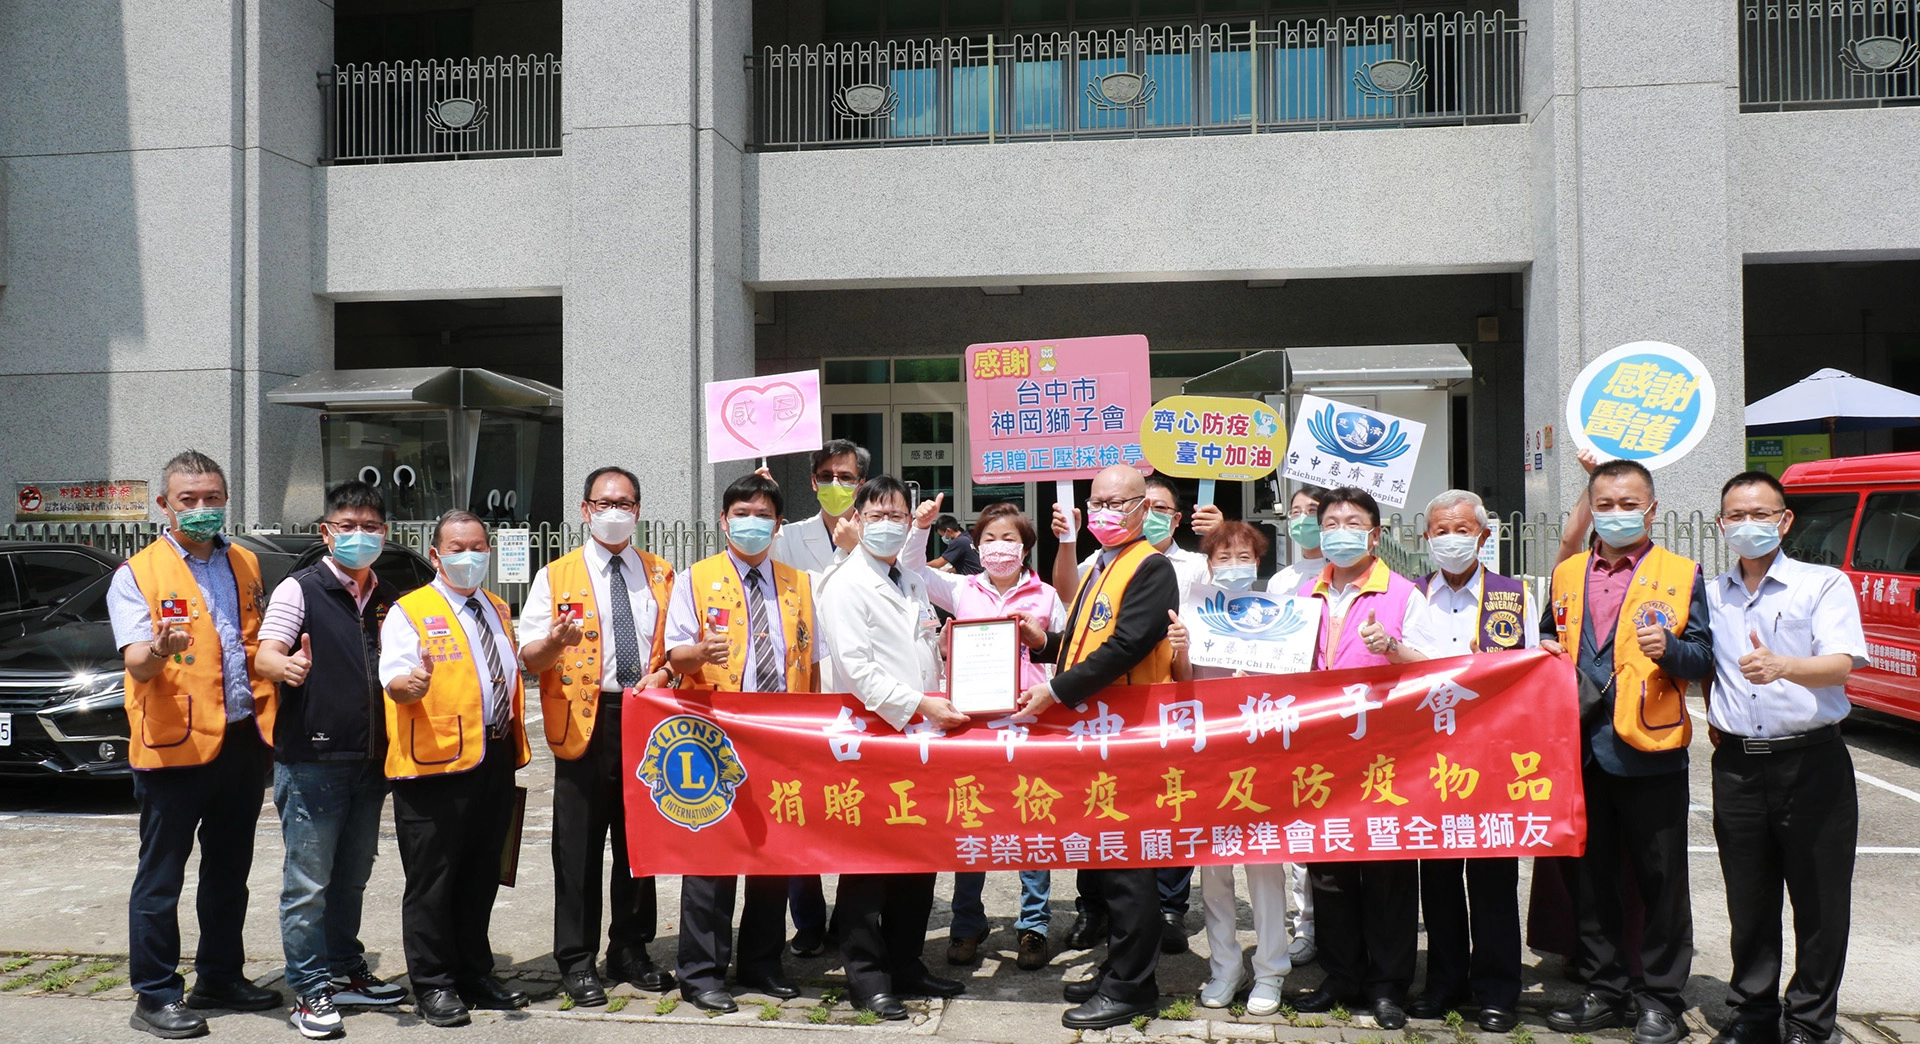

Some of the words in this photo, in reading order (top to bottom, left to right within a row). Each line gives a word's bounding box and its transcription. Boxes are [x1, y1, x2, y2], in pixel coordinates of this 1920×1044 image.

[973, 346, 1031, 379] 感謝
[1016, 377, 1097, 406] 台中市
[1602, 362, 1701, 412] 感謝
[731, 393, 799, 427] 感恩
[990, 404, 1126, 436] 神岡獅子會
[1153, 409, 1251, 438] 齊心防疫
[1583, 399, 1682, 455] 醫護
[910, 449, 945, 460] 感恩樓
[983, 443, 1144, 474] 捐贈正壓採檢亭
[1175, 440, 1273, 468] 臺中加油
[1286, 467, 1327, 486] Taichung
[1366, 488, 1403, 505] Hospital
[1289, 451, 1406, 494] 台中慈濟醫院
[1484, 600, 1523, 615] GOVERNOR
[1487, 591, 1521, 603] DISTRICT
[1499, 622, 1510, 637] L
[1191, 655, 1223, 665] ichung
[1226, 656, 1243, 666] Tzu
[1246, 659, 1263, 668] Chi
[1203, 639, 1309, 664] 中慈濟醫院
[1, 722, 9, 741] 5
[659, 720, 719, 745] LIONS
[822, 674, 1480, 765] 台中市神岡獅子會
[678, 751, 706, 789] L
[768, 750, 1554, 829] 捐贈正壓檢疫亭及防疫物品
[664, 798, 723, 820] INTERNATIONAL
[955, 830, 1130, 866] 李榮志會長
[1139, 817, 1355, 861] 顧子駿準會長
[1366, 811, 1554, 853] 暨全體獅友
